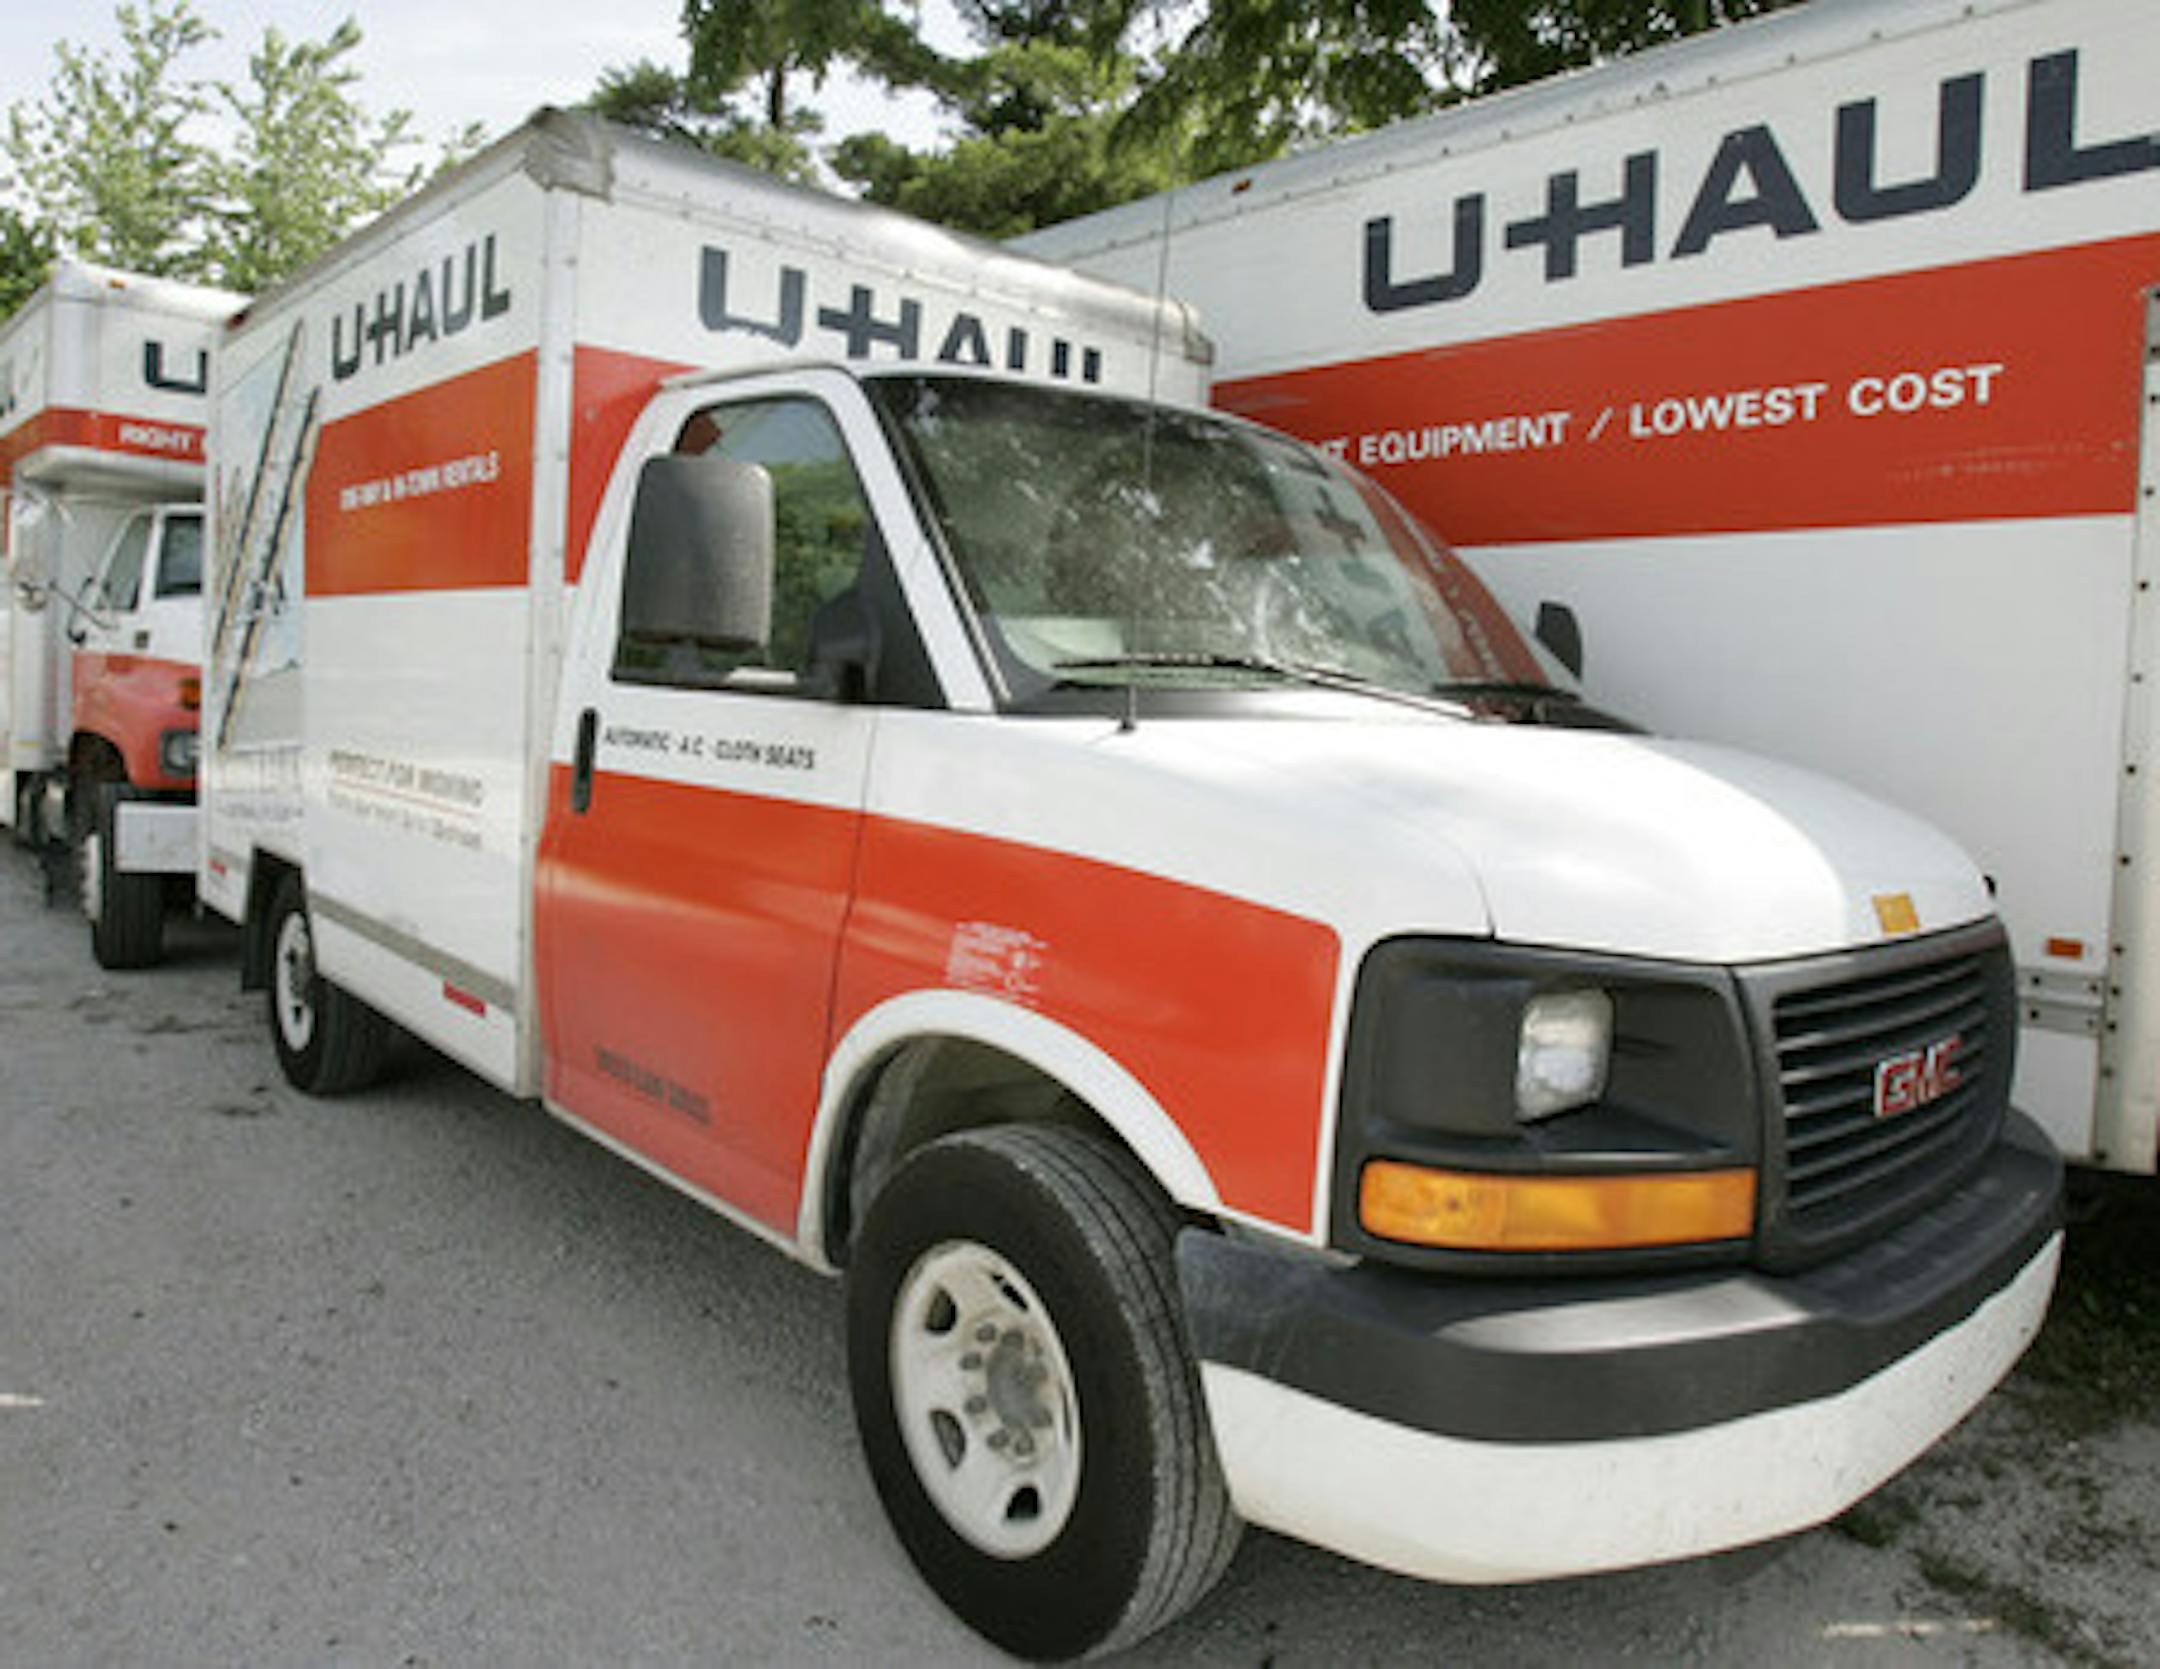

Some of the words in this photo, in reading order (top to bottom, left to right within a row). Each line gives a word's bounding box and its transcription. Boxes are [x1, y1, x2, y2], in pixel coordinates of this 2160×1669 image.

[1363, 47, 2160, 313] U-HAUL
[332, 234, 510, 380] U-HAUL
[1359, 412, 1572, 464] EQUIPMENT
[1629, 383, 1828, 438] LOWEST
[1848, 363, 2004, 417] COST
[1874, 1035, 1963, 1118] GMC
